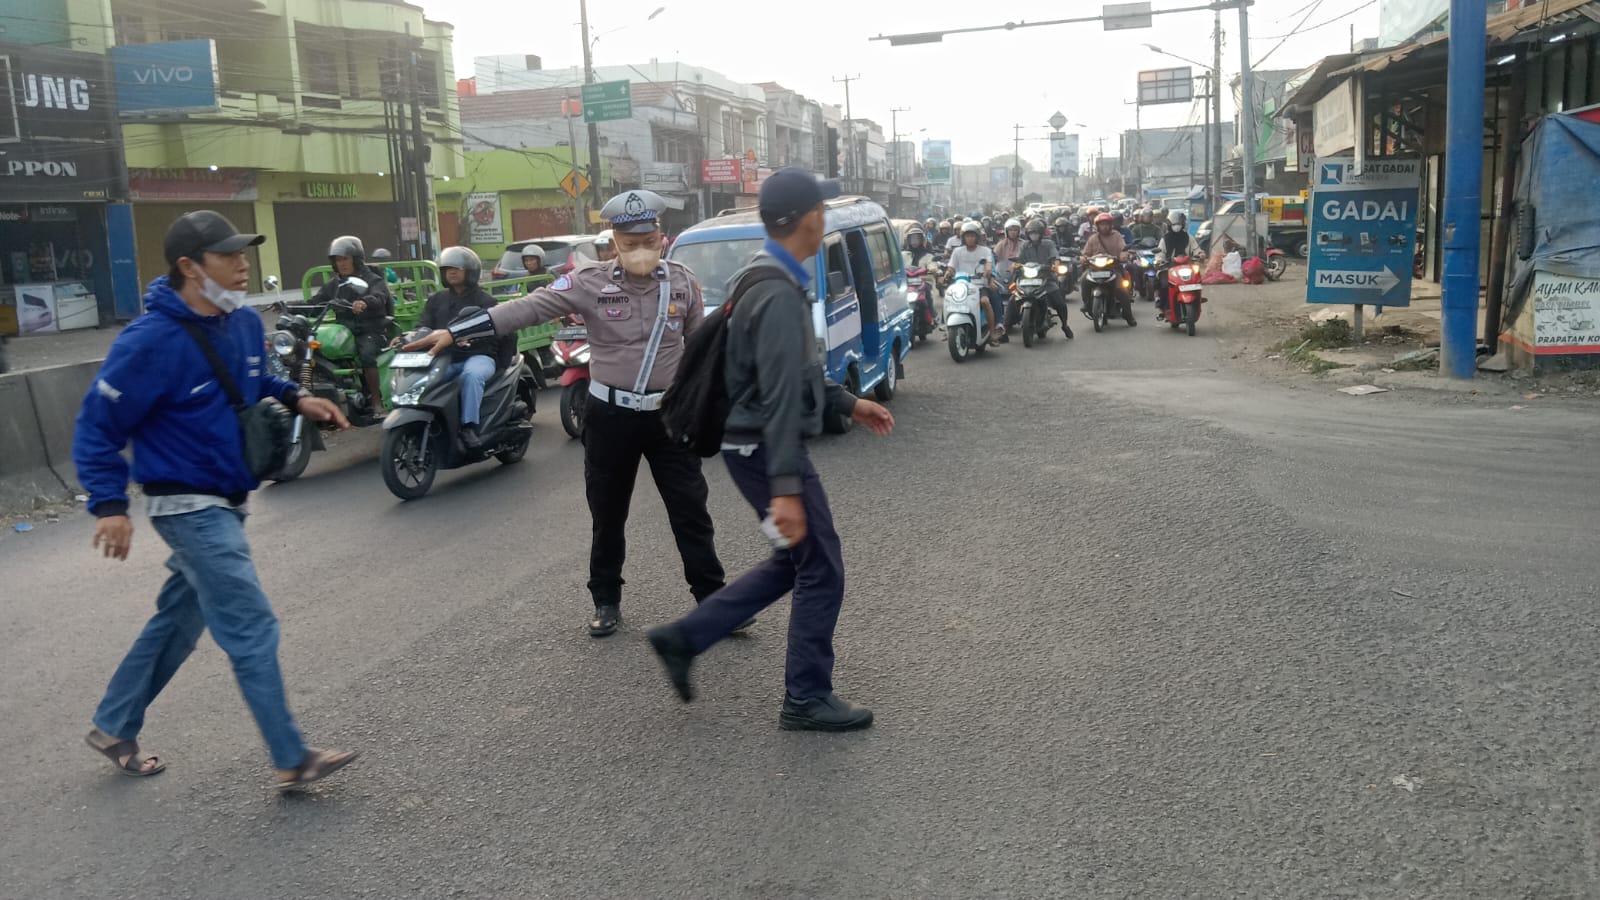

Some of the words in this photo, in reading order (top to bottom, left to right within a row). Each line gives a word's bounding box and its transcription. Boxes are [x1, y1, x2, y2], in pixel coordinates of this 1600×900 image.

[133, 64, 193, 84] vivo
[1347, 164, 1381, 174] PSAT
[1383, 163, 1415, 174] GADAI
[1322, 200, 1408, 221] GADAI
[1320, 273, 1379, 285] MASUK
[1536, 282, 1573, 299] AYAM
[1537, 335, 1585, 344] PRAPATAN
